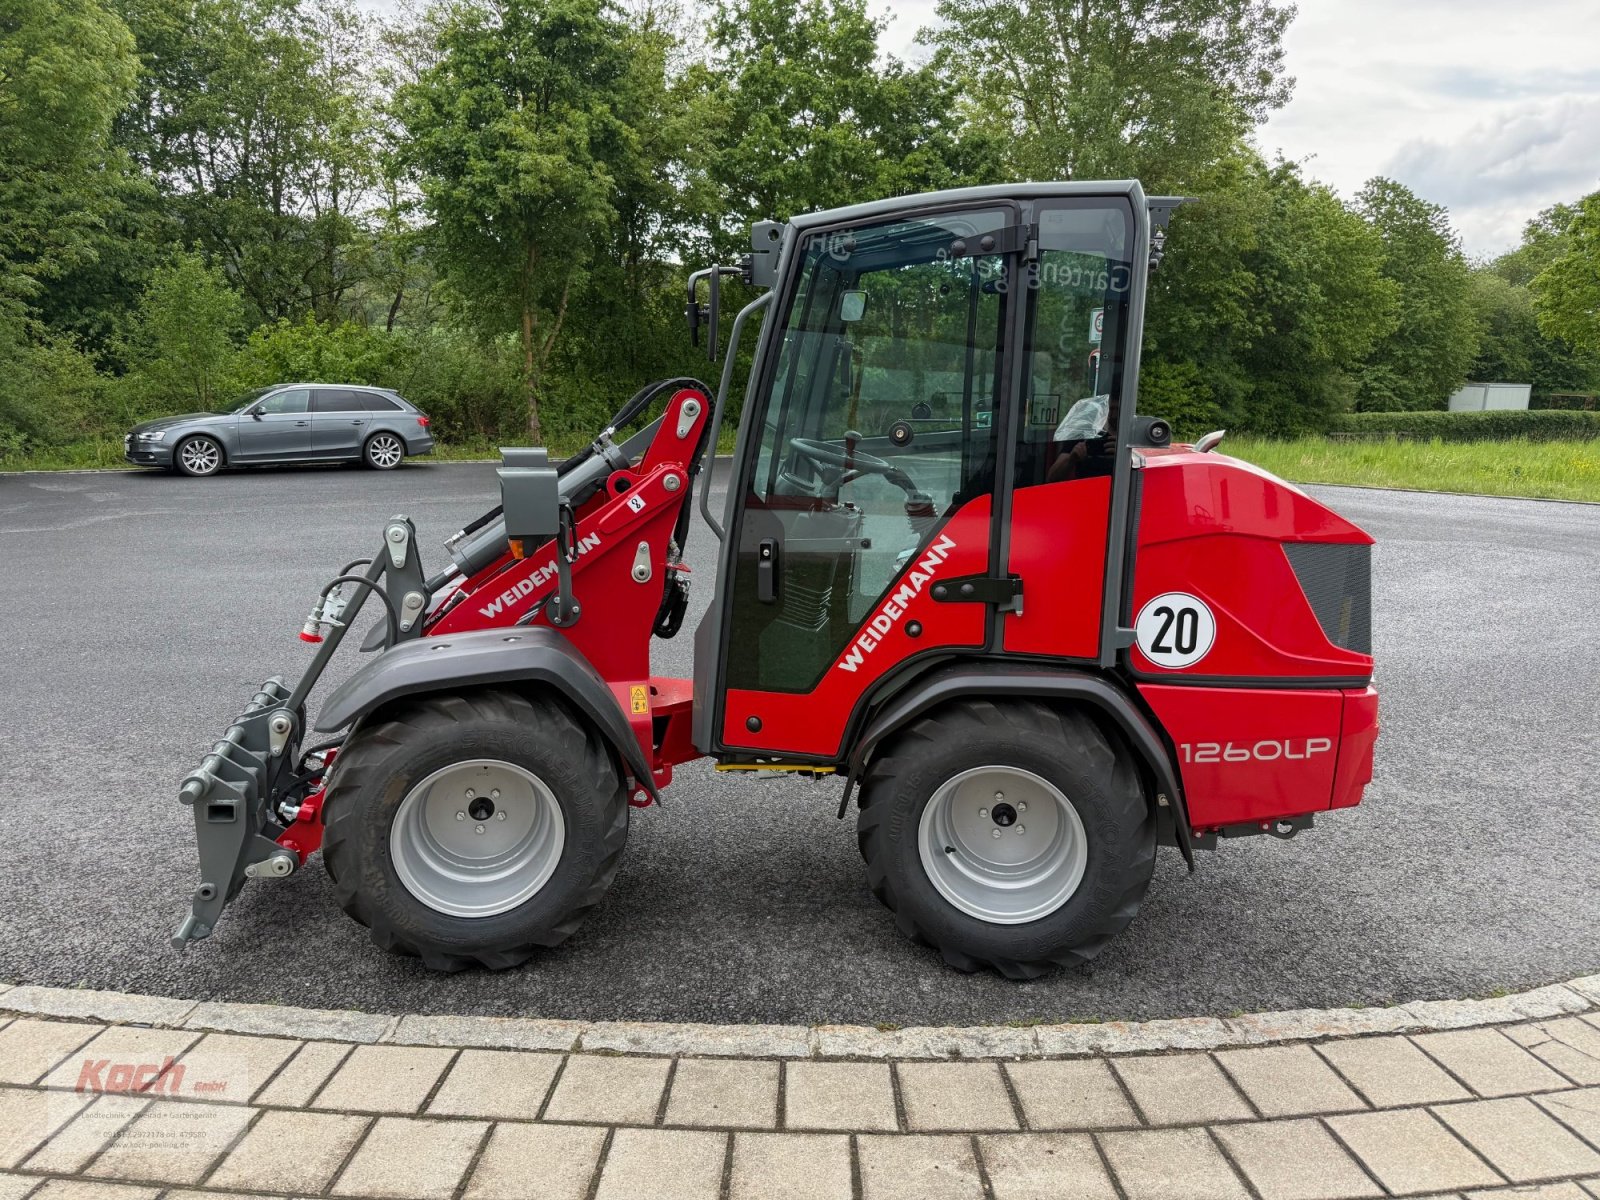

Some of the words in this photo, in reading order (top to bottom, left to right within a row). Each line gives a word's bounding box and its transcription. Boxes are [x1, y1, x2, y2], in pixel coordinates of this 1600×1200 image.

[478, 532, 602, 619] WEIDEMNN
[838, 534, 957, 673] WEIDEMANN
[1150, 605, 1199, 655] 20
[1180, 737, 1332, 763] 1260LP
